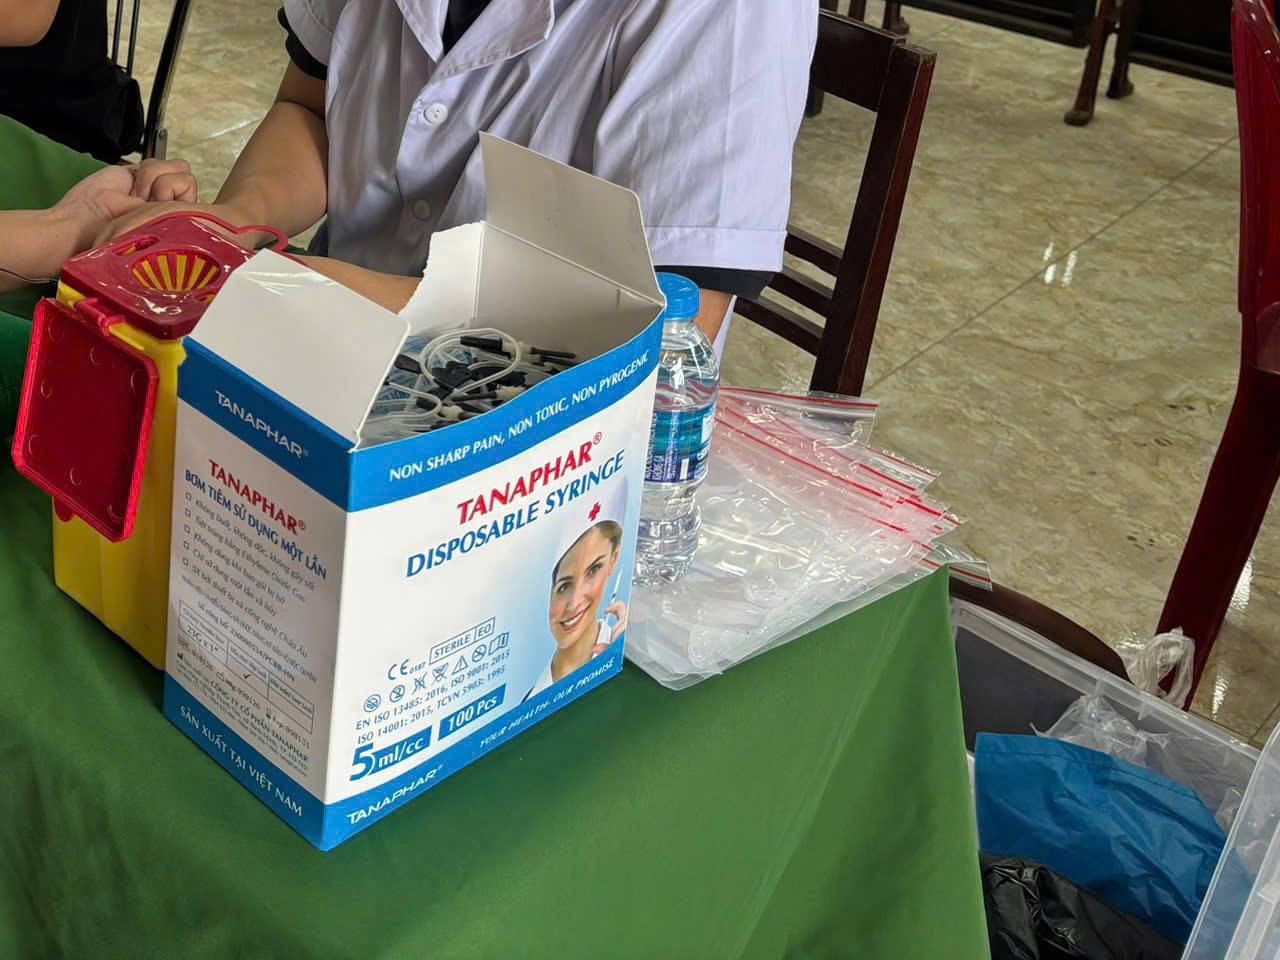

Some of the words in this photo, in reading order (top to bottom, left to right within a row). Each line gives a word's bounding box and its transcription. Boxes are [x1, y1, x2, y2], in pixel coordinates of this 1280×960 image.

[389, 462, 423, 482] NON
[426, 446, 470, 472] SHARP
[473, 431, 505, 455] PAIN,
[508, 416, 533, 439] NON
[535, 397, 569, 425] TOXIC,
[571, 383, 597, 405] NON
[598, 351, 650, 392] PYROGENIC
[185, 469, 206, 494] BƠM
[207, 486, 232, 512] TIÊM
[233, 503, 247, 521] SỬ
[248, 513, 279, 546] DỤNG
[280, 538, 304, 563] MỘT
[406, 500, 540, 578] DISPOSABLE
[544, 448, 625, 515] SYRINGE
[433, 634, 471, 659] STERILE
[477, 623, 492, 638] EO
[356, 718, 370, 730] EN
[374, 710, 390, 724] ISO
[393, 698, 423, 716] 13485:
[450, 675, 466, 689] ISO
[467, 663, 489, 680] 9001:
[491, 649, 511, 666] 2015
[357, 731, 374, 744] ISO
[377, 719, 408, 737] 14001:
[410, 707, 434, 723] 2015,
[437, 690, 460, 709] TCVN
[486, 665, 506, 682] 1995
[448, 707, 474, 732] 100
[475, 695, 498, 716] Pcs
[479, 727, 507, 748] YOUR
[553, 686, 574, 703] OUR
[575, 656, 616, 690] PROMISE
[179, 705, 200, 729] SẢN
[201, 724, 227, 753] XUẤT
[229, 748, 246, 770] TẠI
[249, 766, 273, 792] VIỆT
[275, 788, 303, 817] NAM
[271, 728, 308, 764] TANAPHAR
